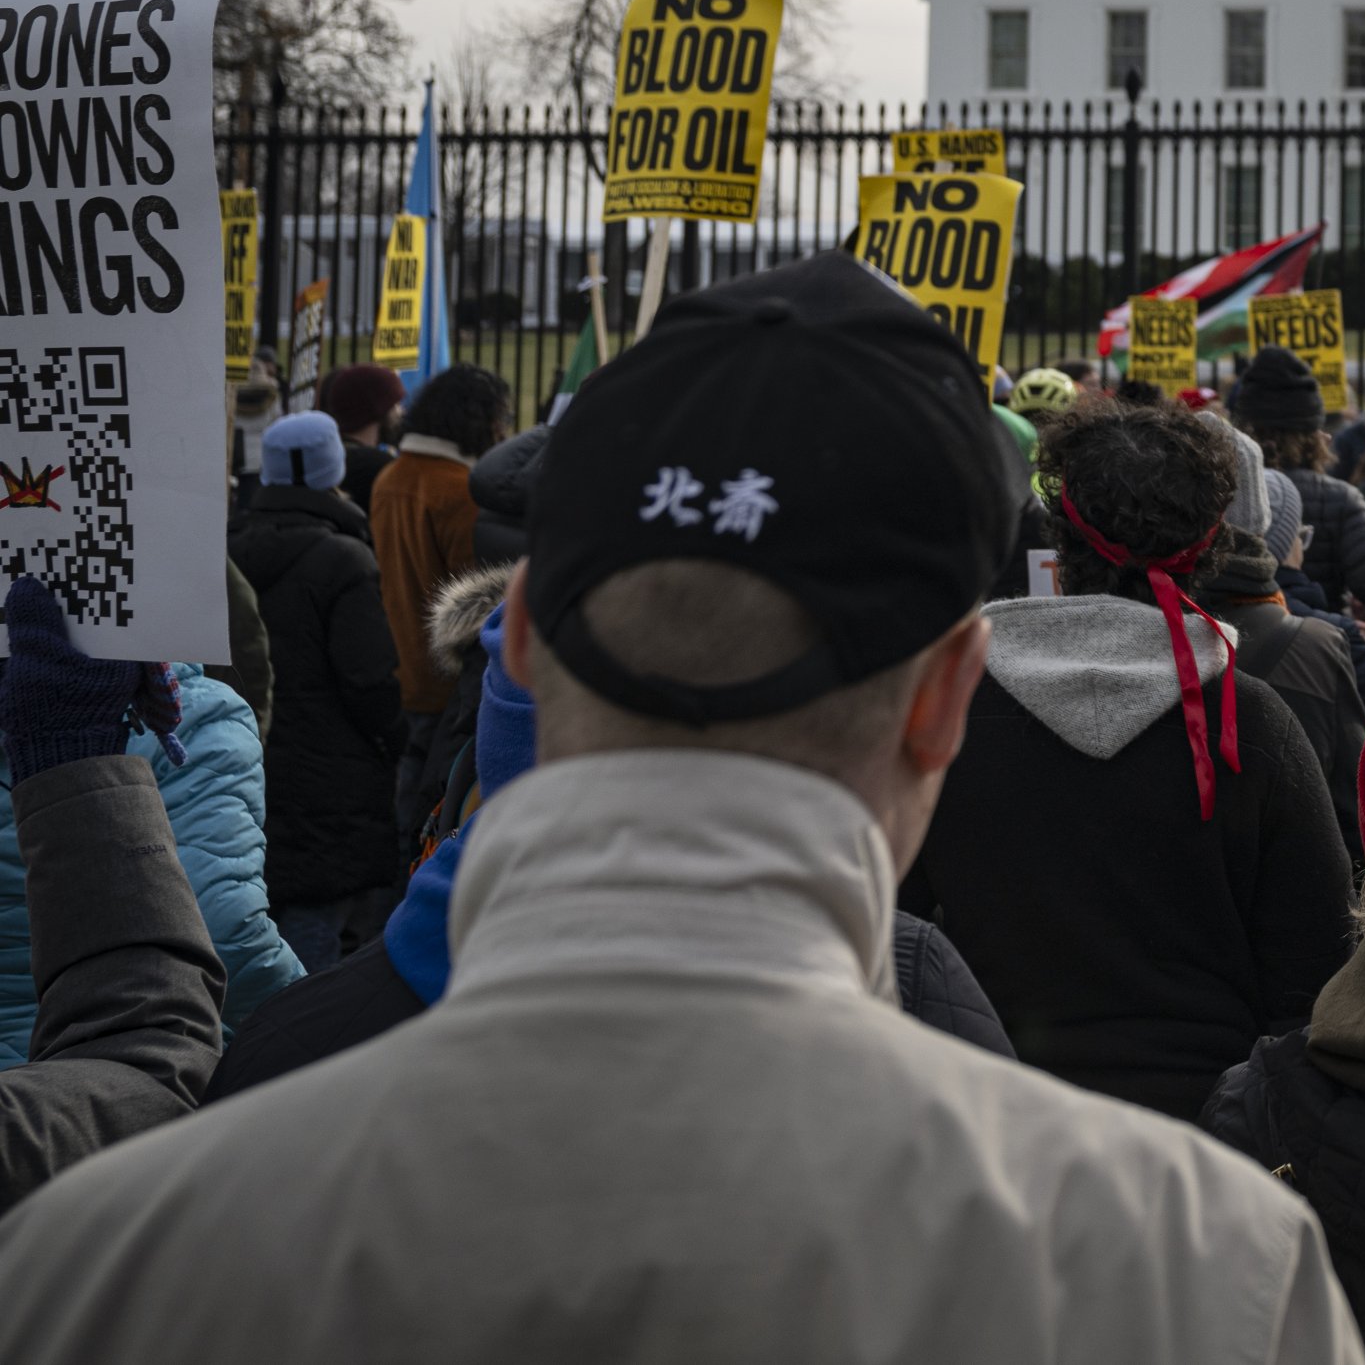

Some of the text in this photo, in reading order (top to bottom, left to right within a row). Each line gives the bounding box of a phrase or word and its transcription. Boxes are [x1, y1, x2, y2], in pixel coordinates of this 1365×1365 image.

[622, 26, 768, 97] BLOOD
[611, 106, 757, 176] FOR OIL
[897, 133, 998, 158] U.S. HANDS
[894, 179, 980, 213] NO
[0, 195, 185, 316] INGS
[863, 216, 1002, 292] BLOOD
[1133, 315, 1193, 348] NEEDS
[1253, 311, 1338, 350] NEEDS
